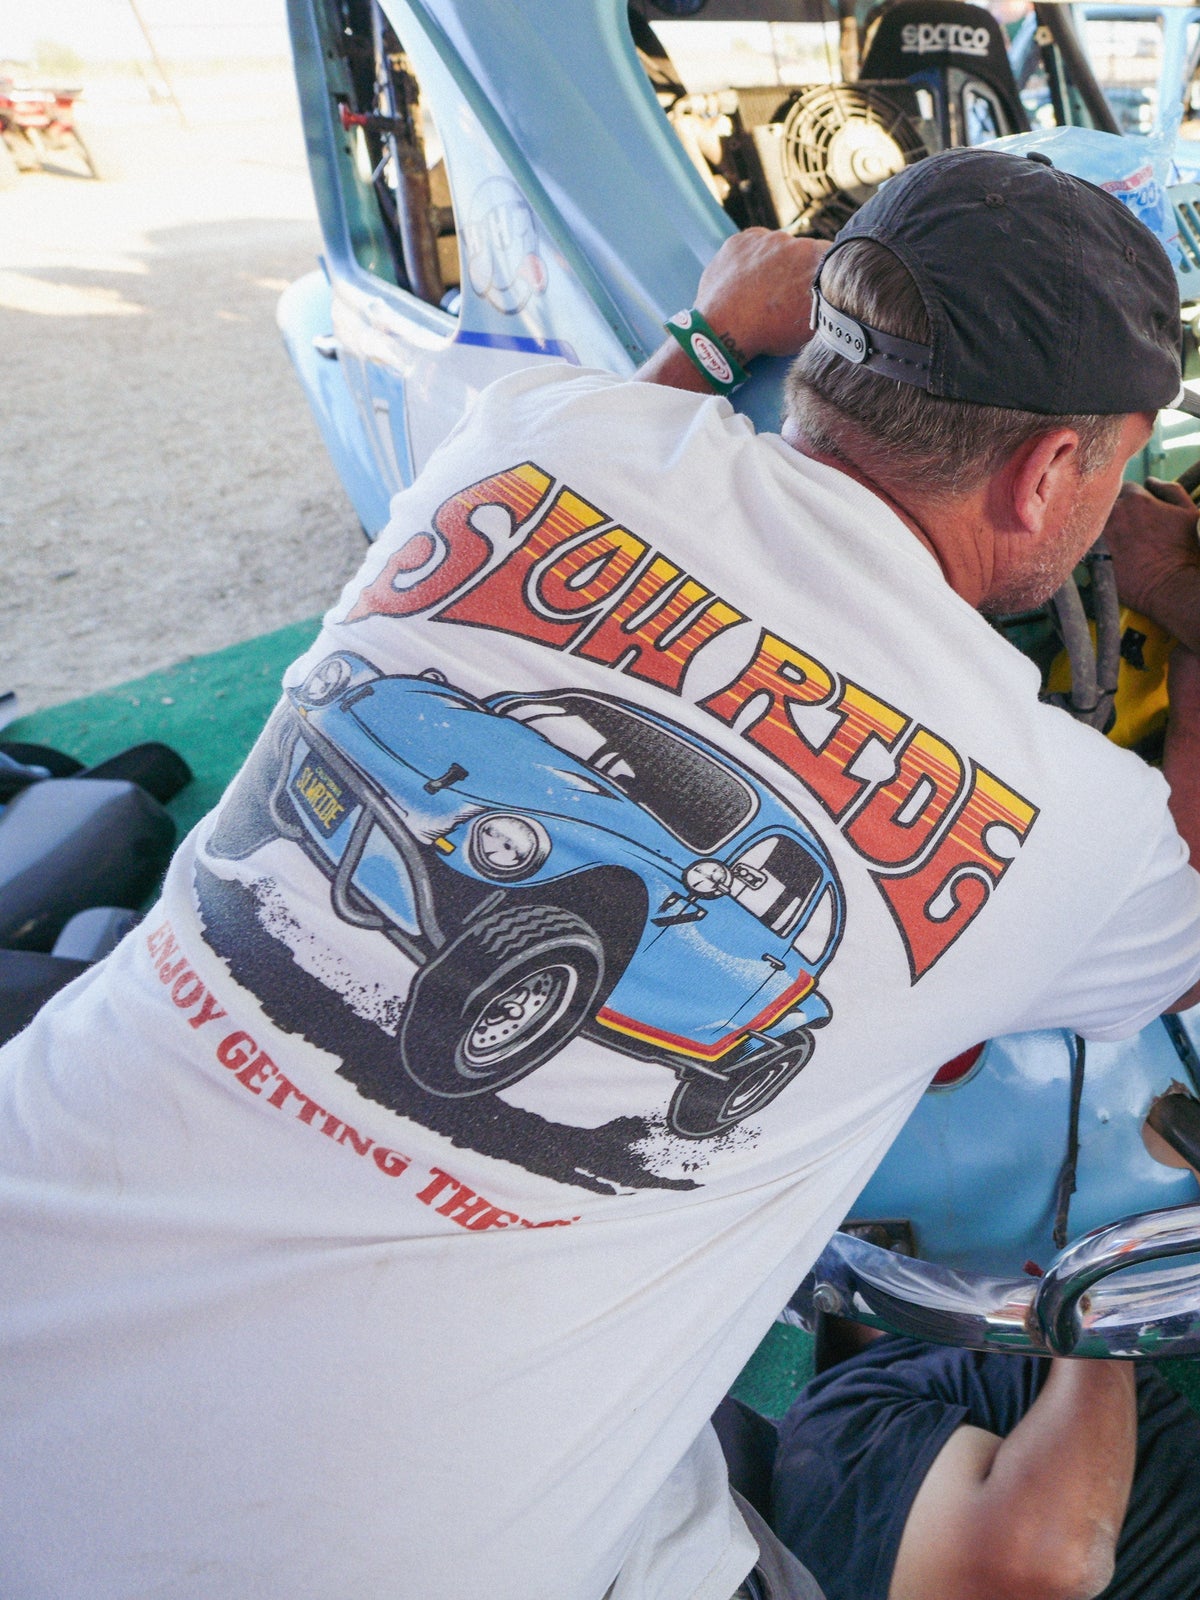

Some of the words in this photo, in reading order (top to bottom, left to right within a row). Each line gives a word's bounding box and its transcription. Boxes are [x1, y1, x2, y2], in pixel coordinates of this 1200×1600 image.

[901, 23, 990, 54] sparco
[334, 460, 752, 696] SLOW
[147, 920, 228, 1030] ENJOY
[216, 1030, 413, 1178] GETTING
[416, 1166, 582, 1232] THE
